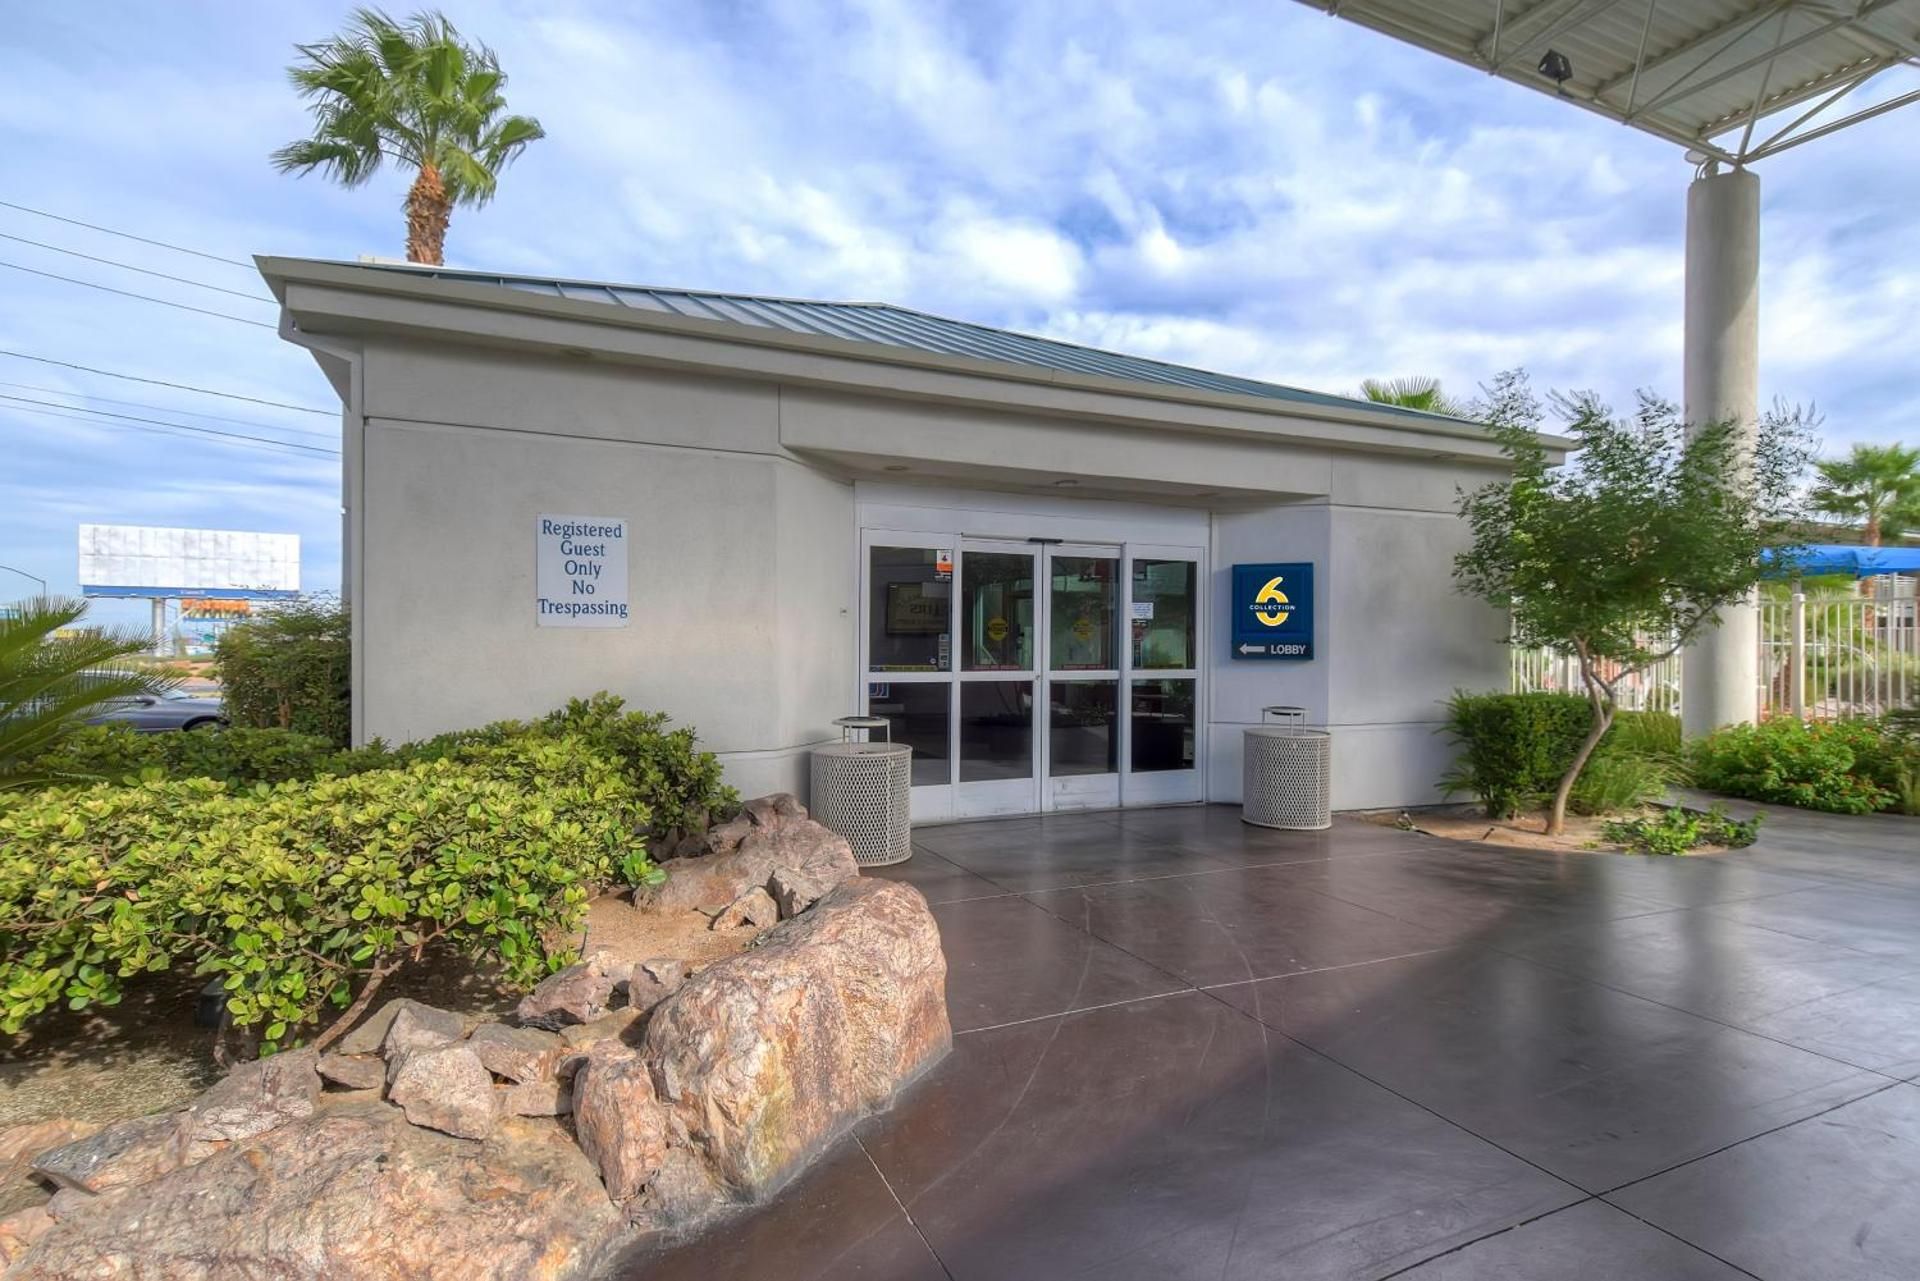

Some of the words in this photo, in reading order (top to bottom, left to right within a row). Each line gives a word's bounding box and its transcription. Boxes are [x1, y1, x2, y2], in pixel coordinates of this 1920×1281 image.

[542, 519, 622, 539] Registered
[560, 540, 605, 557] Guest
[564, 560, 602, 579] Only
[572, 580, 595, 595] No
[537, 599, 628, 618] Trespassing
[1255, 576, 1289, 626] 6
[1270, 644, 1306, 655] LOBBY
